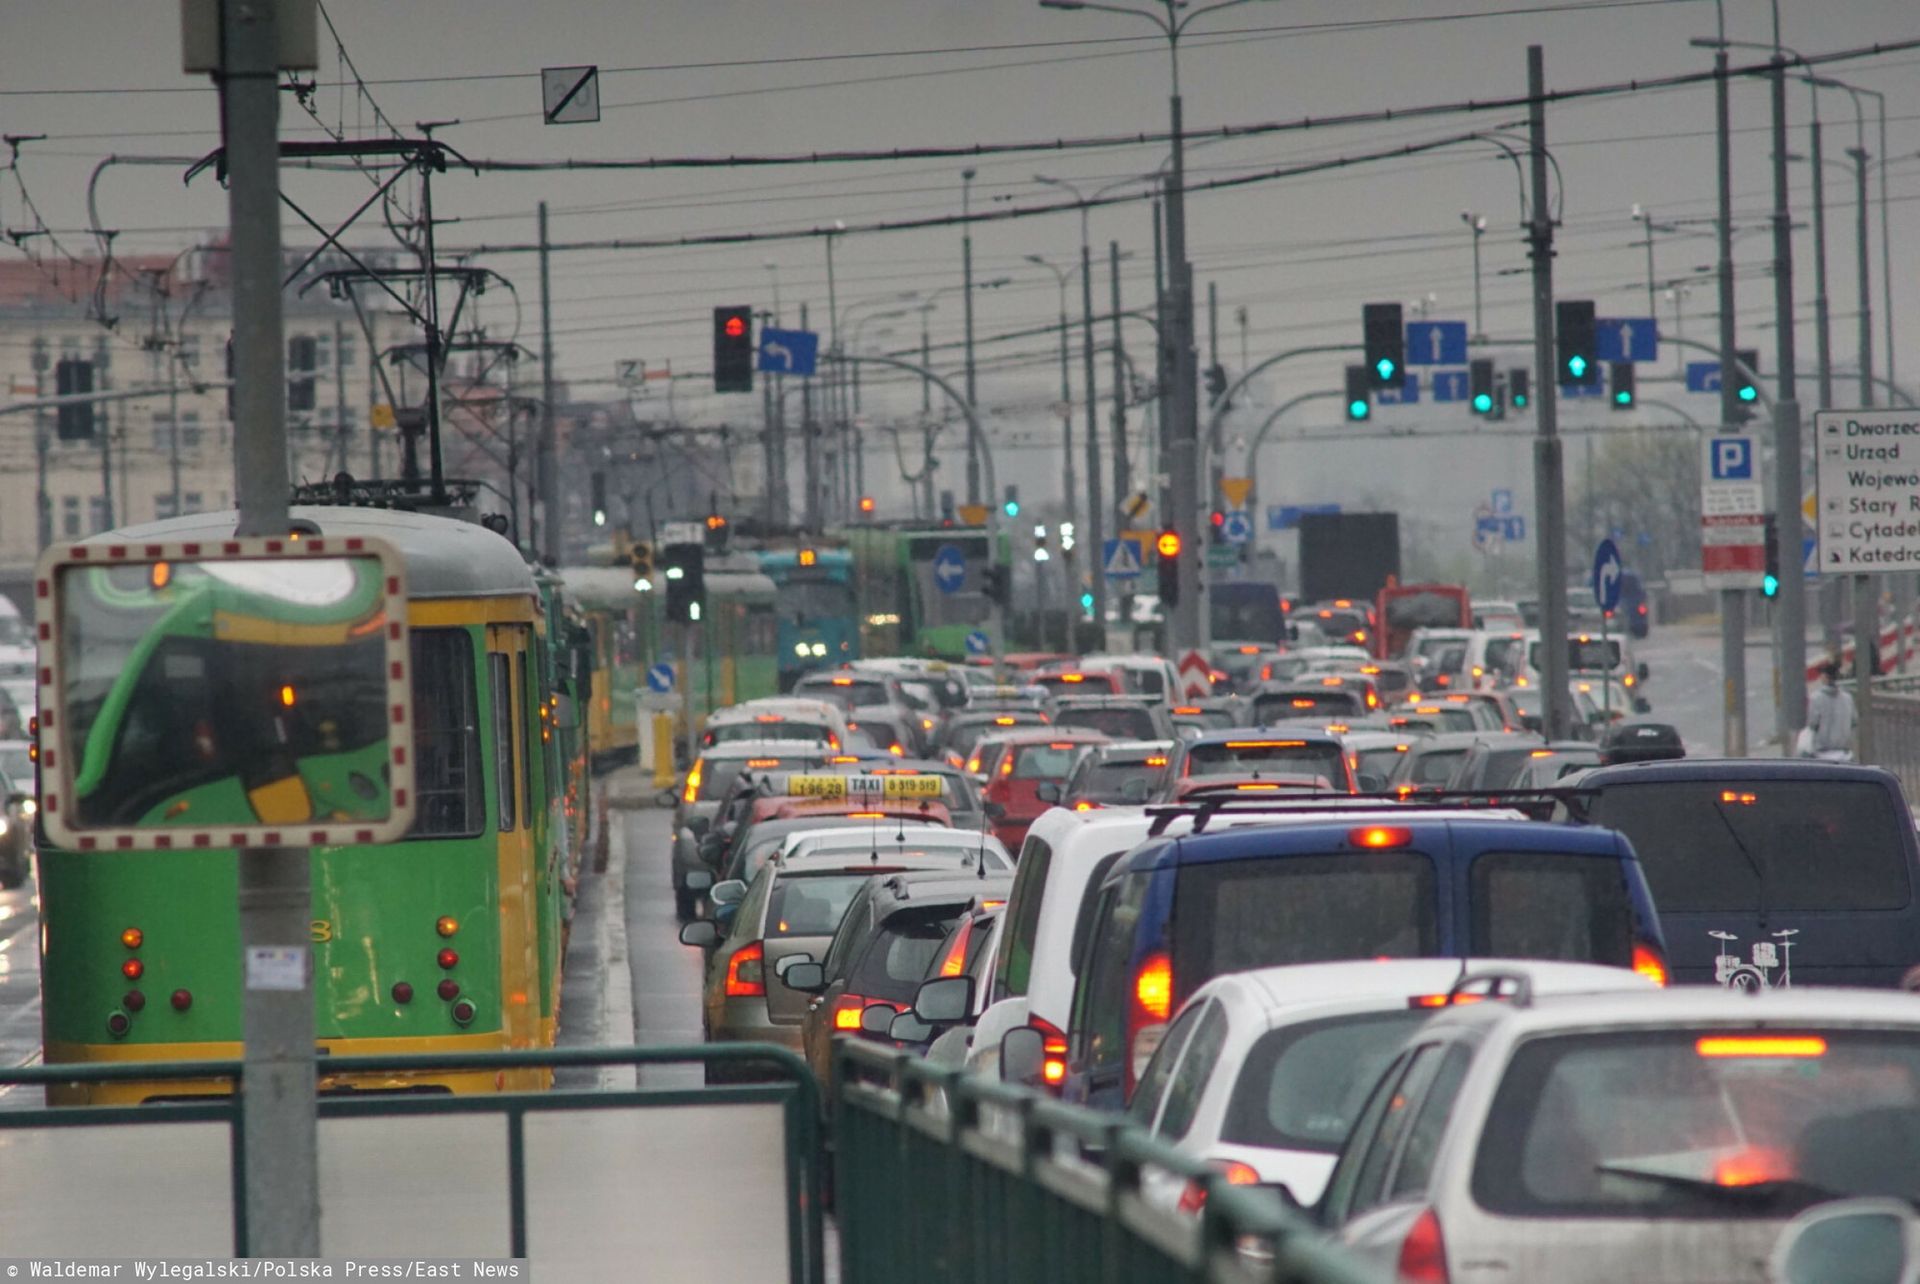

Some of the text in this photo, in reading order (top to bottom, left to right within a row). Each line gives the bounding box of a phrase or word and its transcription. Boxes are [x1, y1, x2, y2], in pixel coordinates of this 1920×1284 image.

[1847, 420, 1920, 436] Dworzec
[1719, 443, 1743, 476] P
[1847, 443, 1899, 464] Urząd
[1849, 497, 1897, 518] Stary
[852, 778, 880, 791] TAXI
